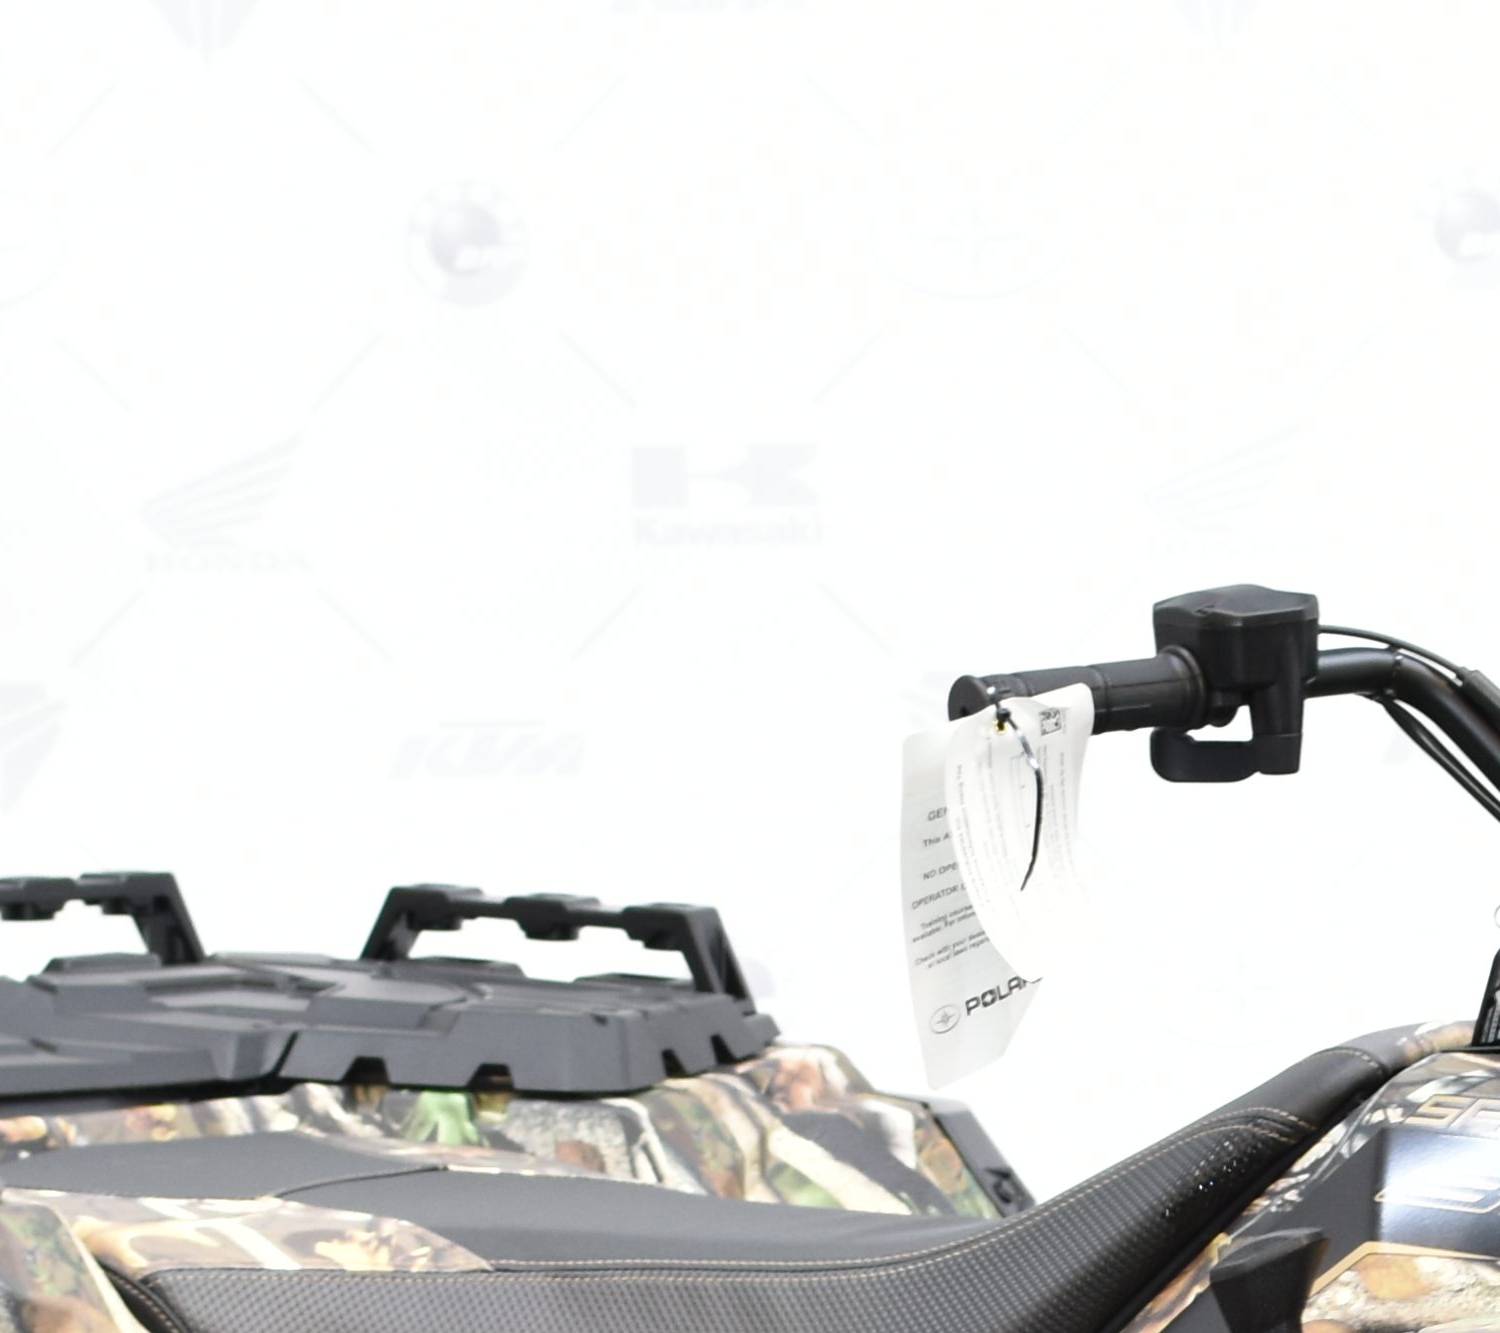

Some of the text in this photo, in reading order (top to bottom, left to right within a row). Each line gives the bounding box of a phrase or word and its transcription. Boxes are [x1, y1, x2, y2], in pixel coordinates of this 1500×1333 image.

[631, 516, 824, 548] Kawasaki
[386, 718, 587, 779] KTM
[965, 976, 1043, 1016] POLA
